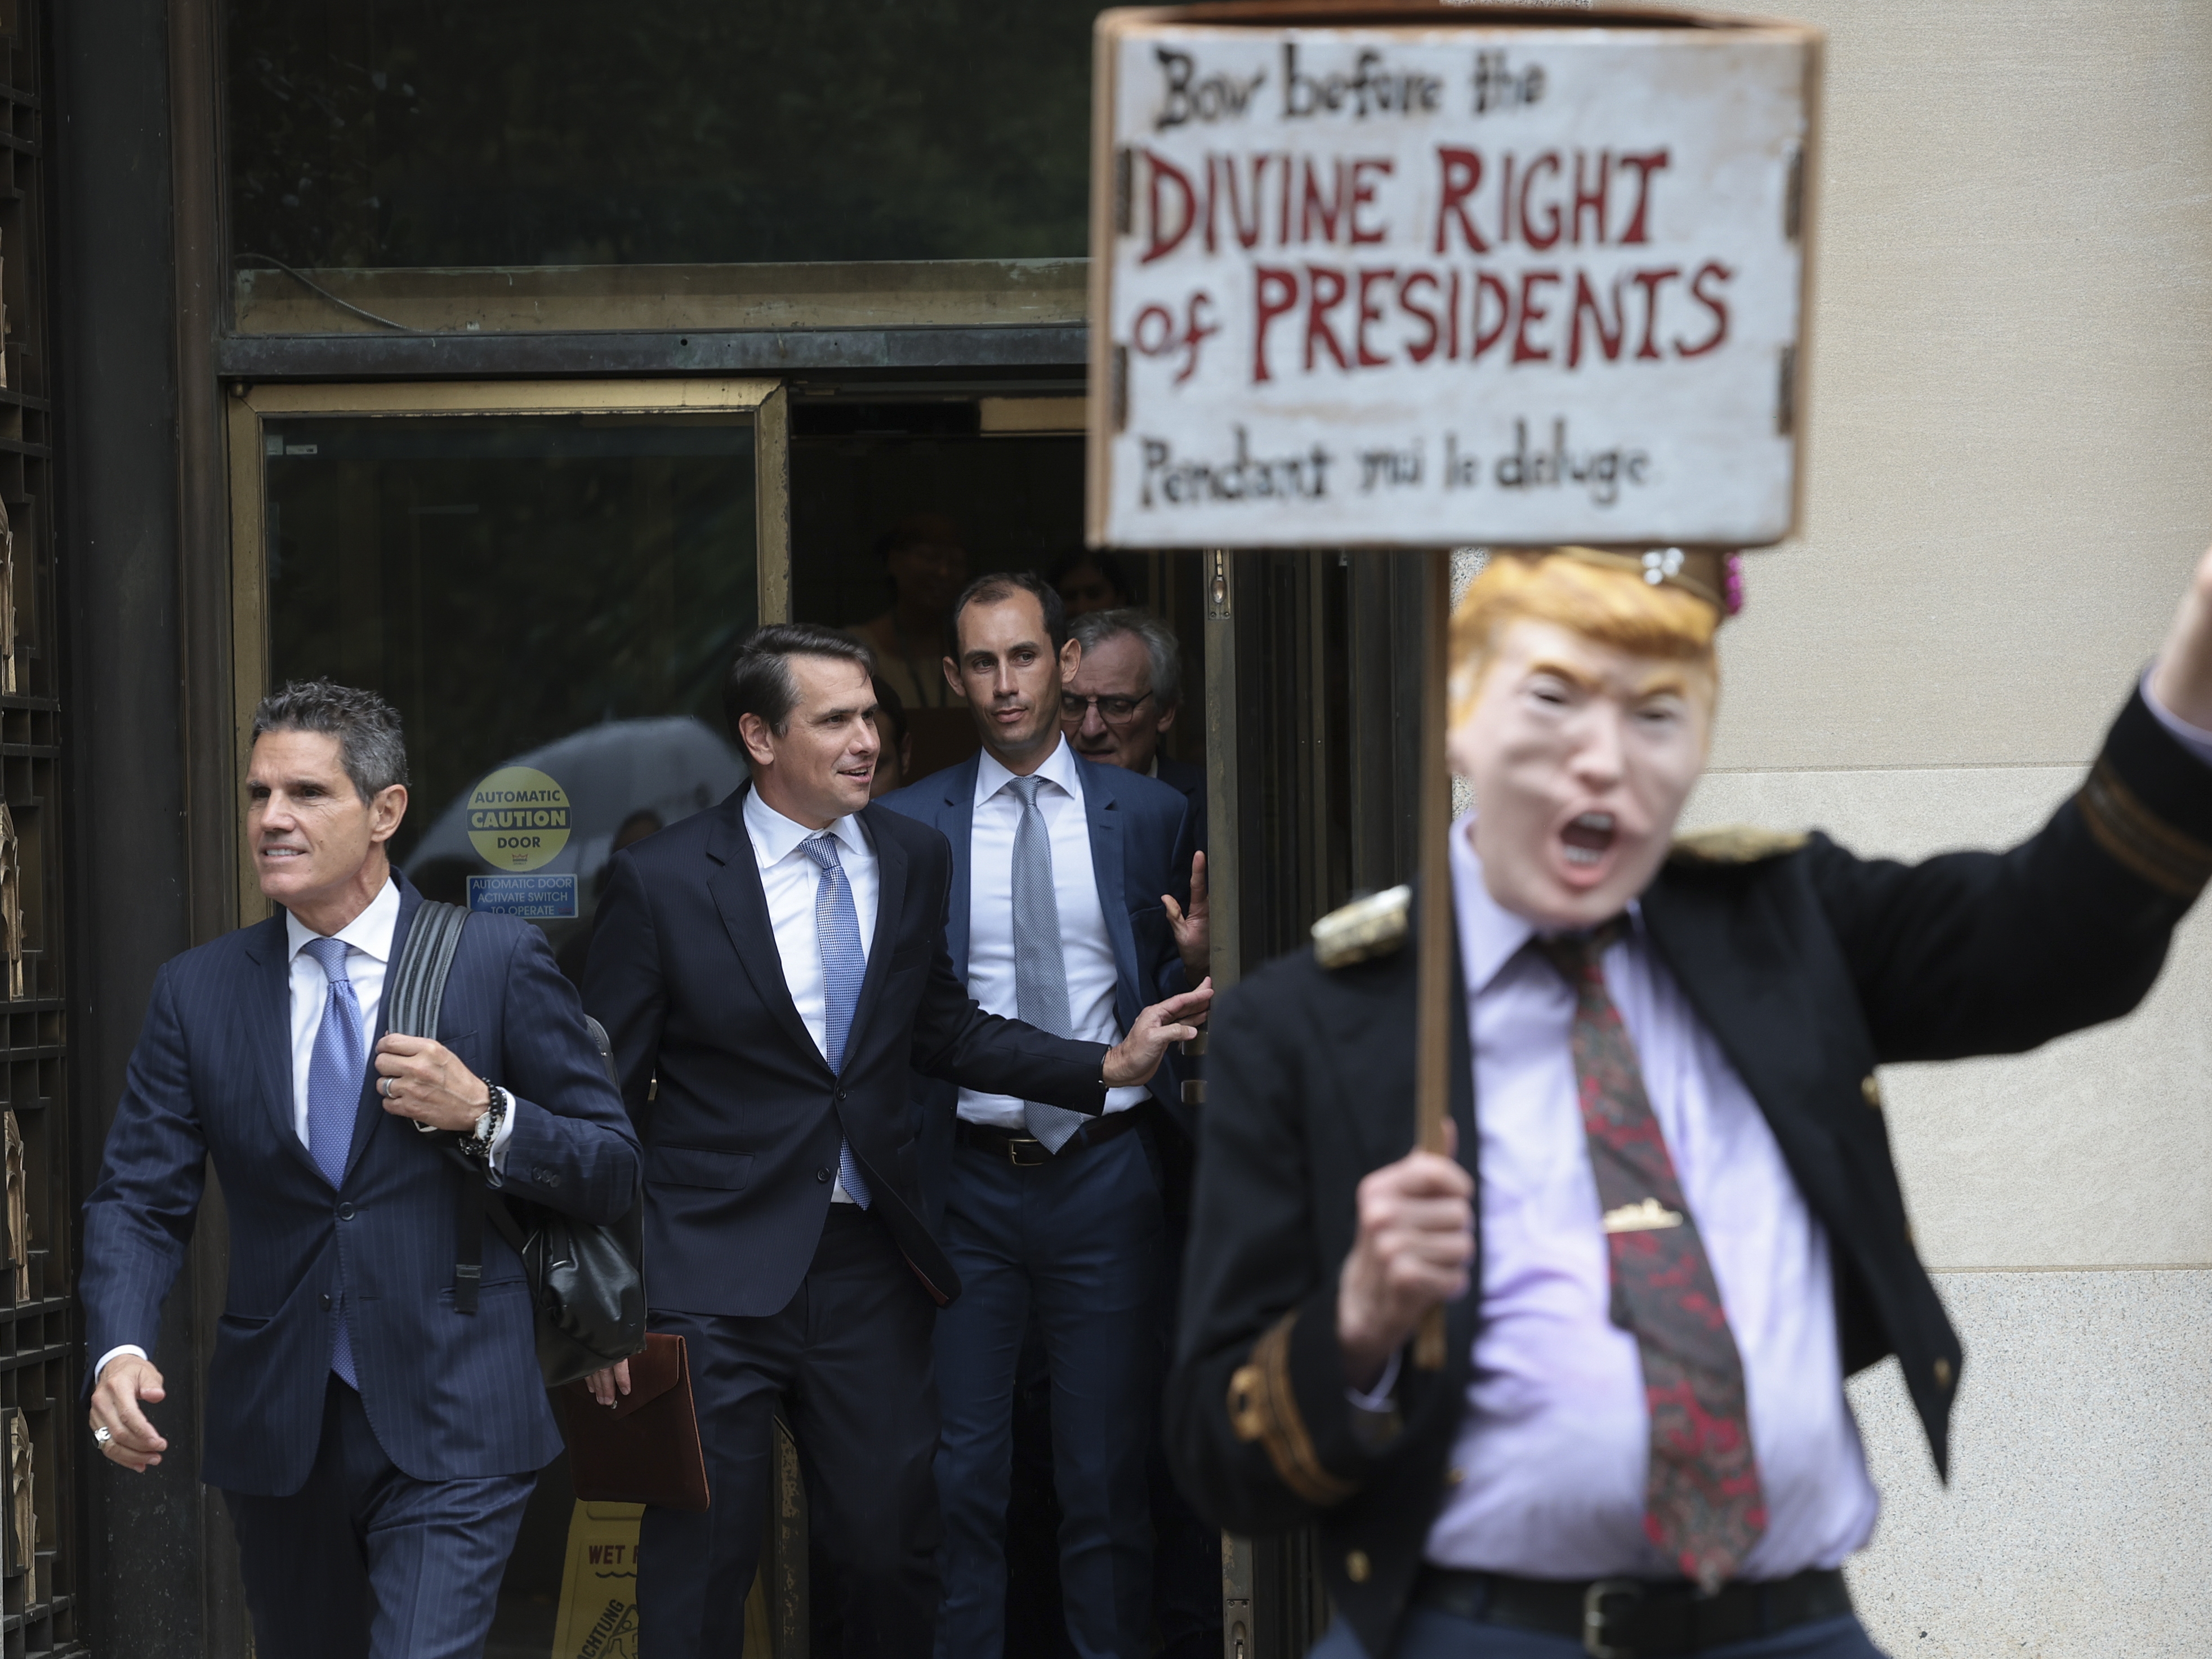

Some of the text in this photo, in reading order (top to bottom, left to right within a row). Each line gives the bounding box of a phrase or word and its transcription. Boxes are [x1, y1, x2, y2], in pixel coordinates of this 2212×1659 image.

[1282, 42, 1446, 117] before
[1473, 48, 1547, 115] the
[1139, 143, 1671, 265] DIVINE RIGHT
[1132, 260, 1737, 390] of PRESIDENTS
[1140, 423, 1332, 511] Pendant
[1443, 428, 1479, 492] le
[474, 790, 561, 804] AUTOMATIC
[471, 810, 567, 829] CAUTION
[497, 836, 541, 849] DOOR
[472, 878, 573, 890] AUTOMATIC DOOR
[477, 891, 568, 903] ACTIVATE SWITCH
[490, 906, 506, 915] TO
[508, 905, 555, 916] OPERATE
[588, 1545, 626, 1564] WET
